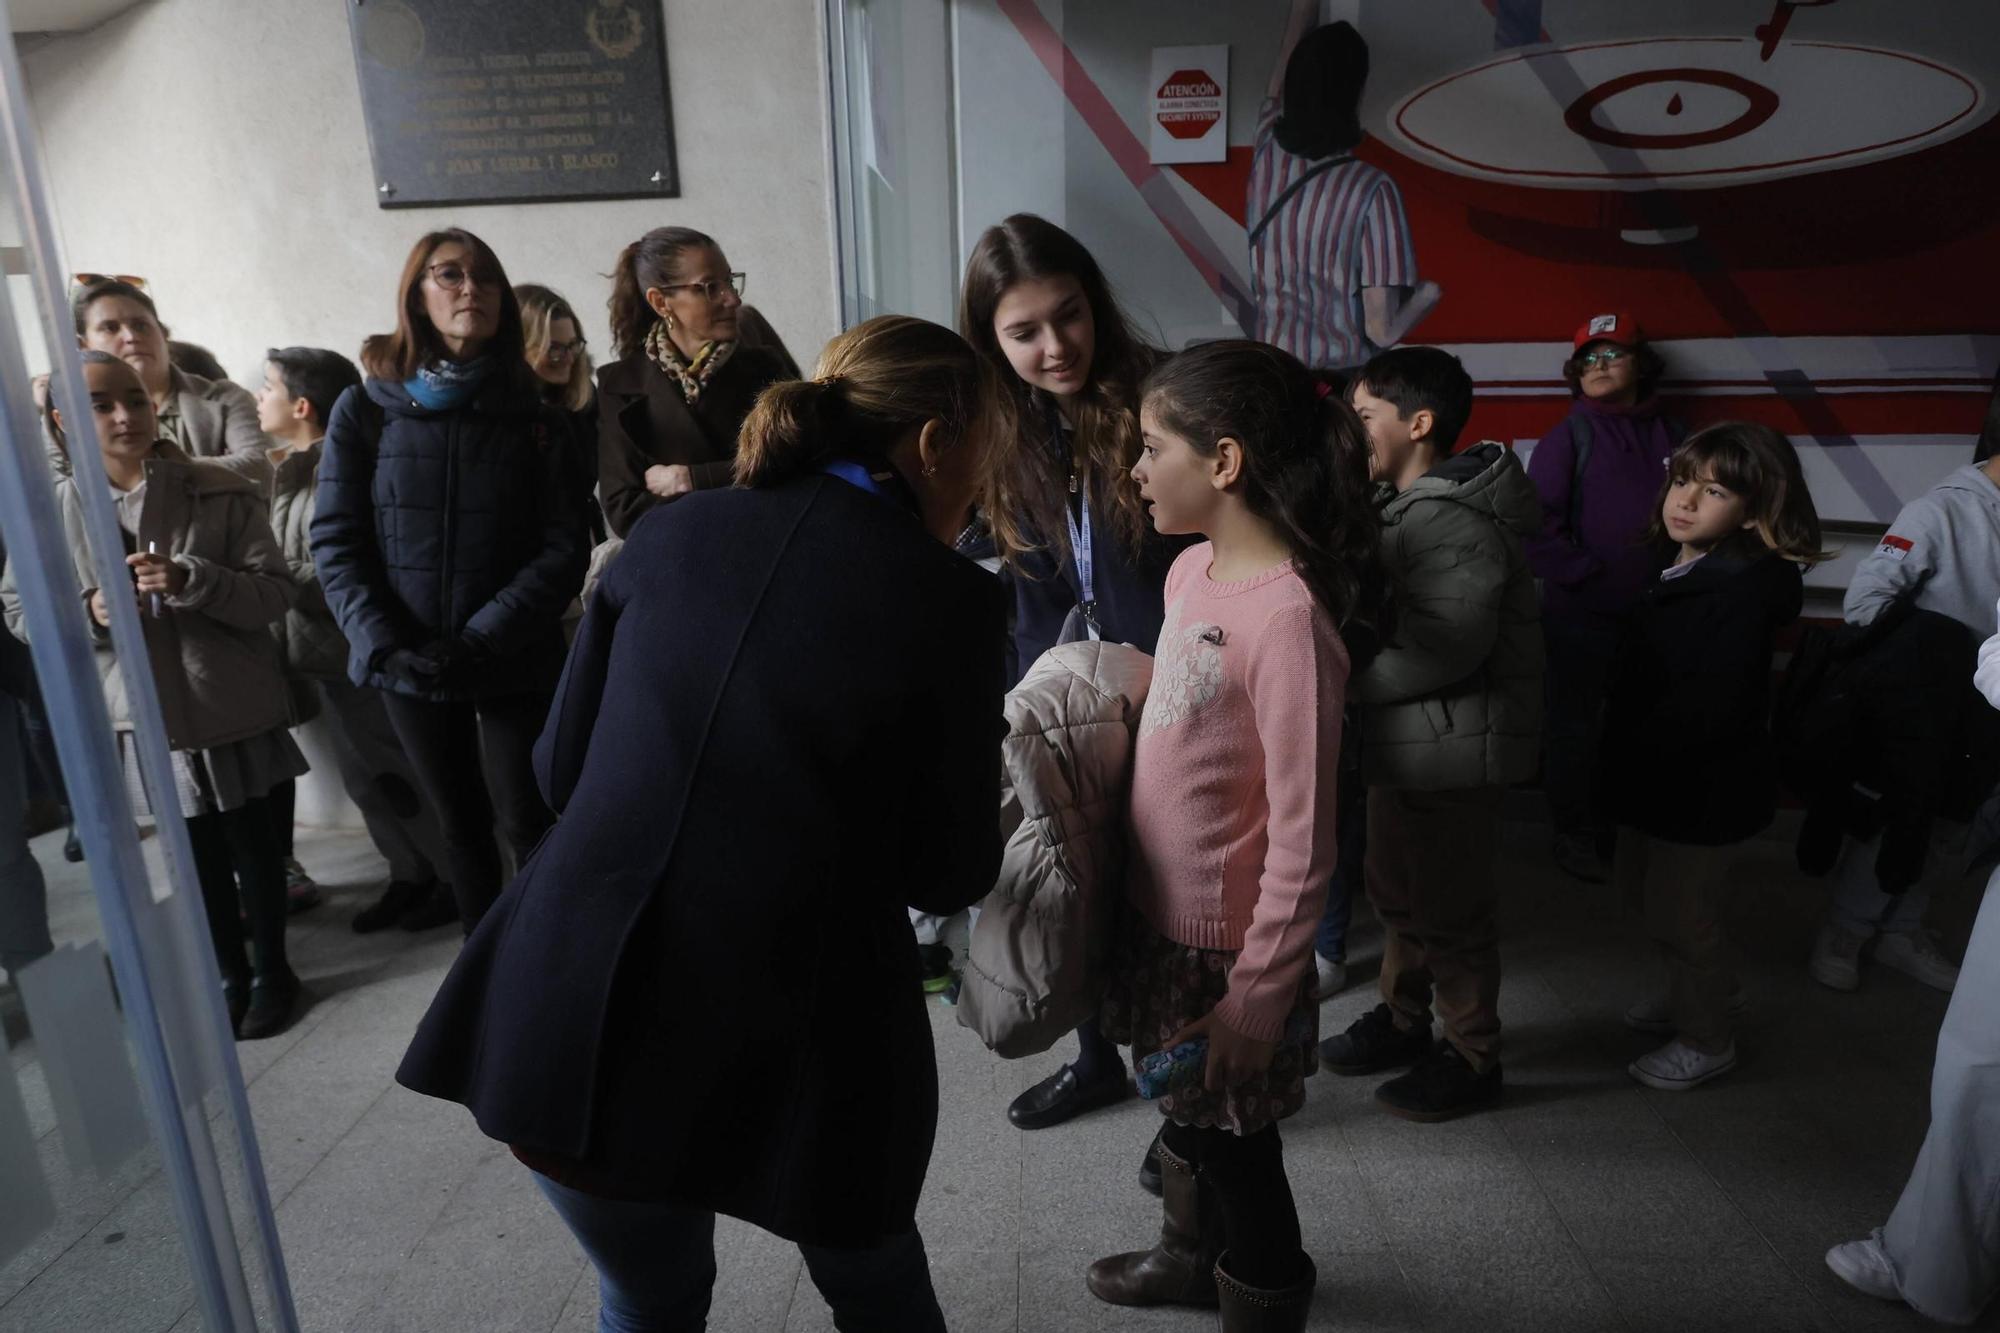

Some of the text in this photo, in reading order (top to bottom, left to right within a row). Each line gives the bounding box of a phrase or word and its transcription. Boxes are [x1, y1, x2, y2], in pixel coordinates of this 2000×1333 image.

[1163, 82, 1215, 97] ATENCIÓN
[1193, 112, 1218, 121] SYSTEM
[561, 152, 619, 170] BLASCO
